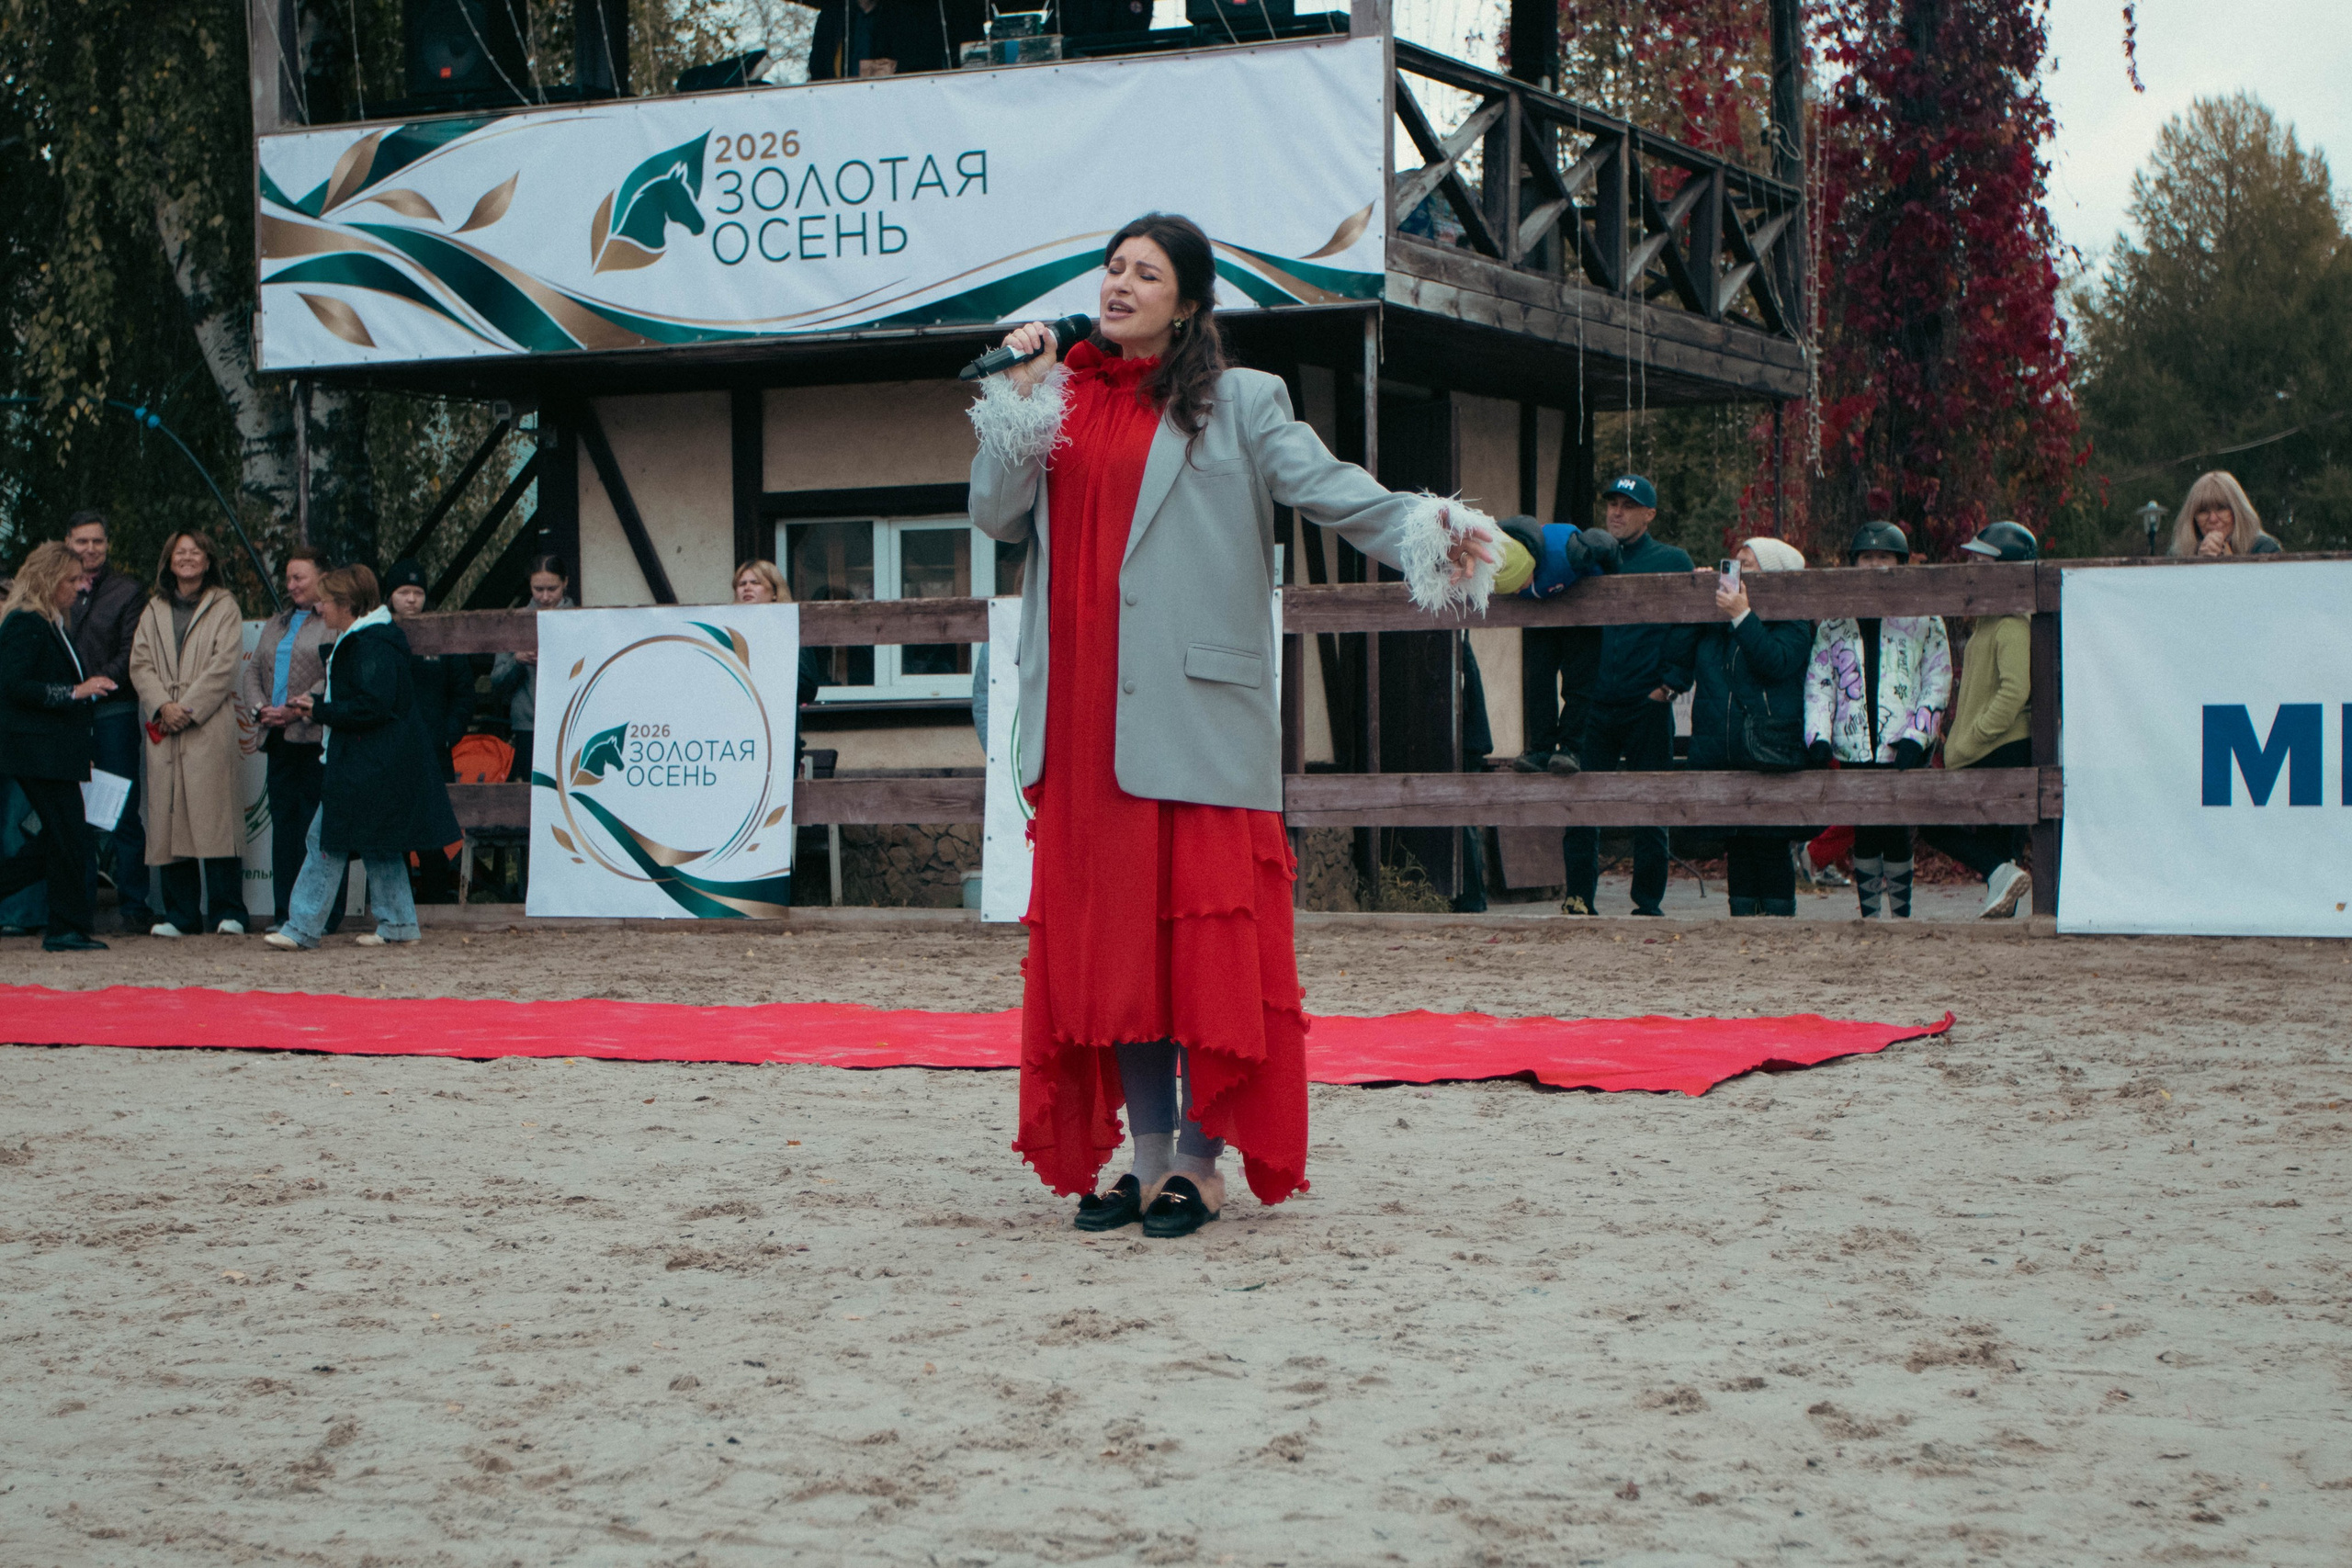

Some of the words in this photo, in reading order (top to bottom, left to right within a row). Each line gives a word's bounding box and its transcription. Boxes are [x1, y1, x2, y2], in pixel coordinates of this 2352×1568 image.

[715, 130, 800, 163] 2026
[715, 149, 989, 215] ЗОЛОТАЯ
[712, 210, 909, 265] ОСЕНЬ
[629, 724, 671, 739] 2026
[628, 739, 755, 762] ЗОЛОТАЯ
[2201, 703, 2352, 807] М
[627, 764, 717, 787] ОСЕНЬ
